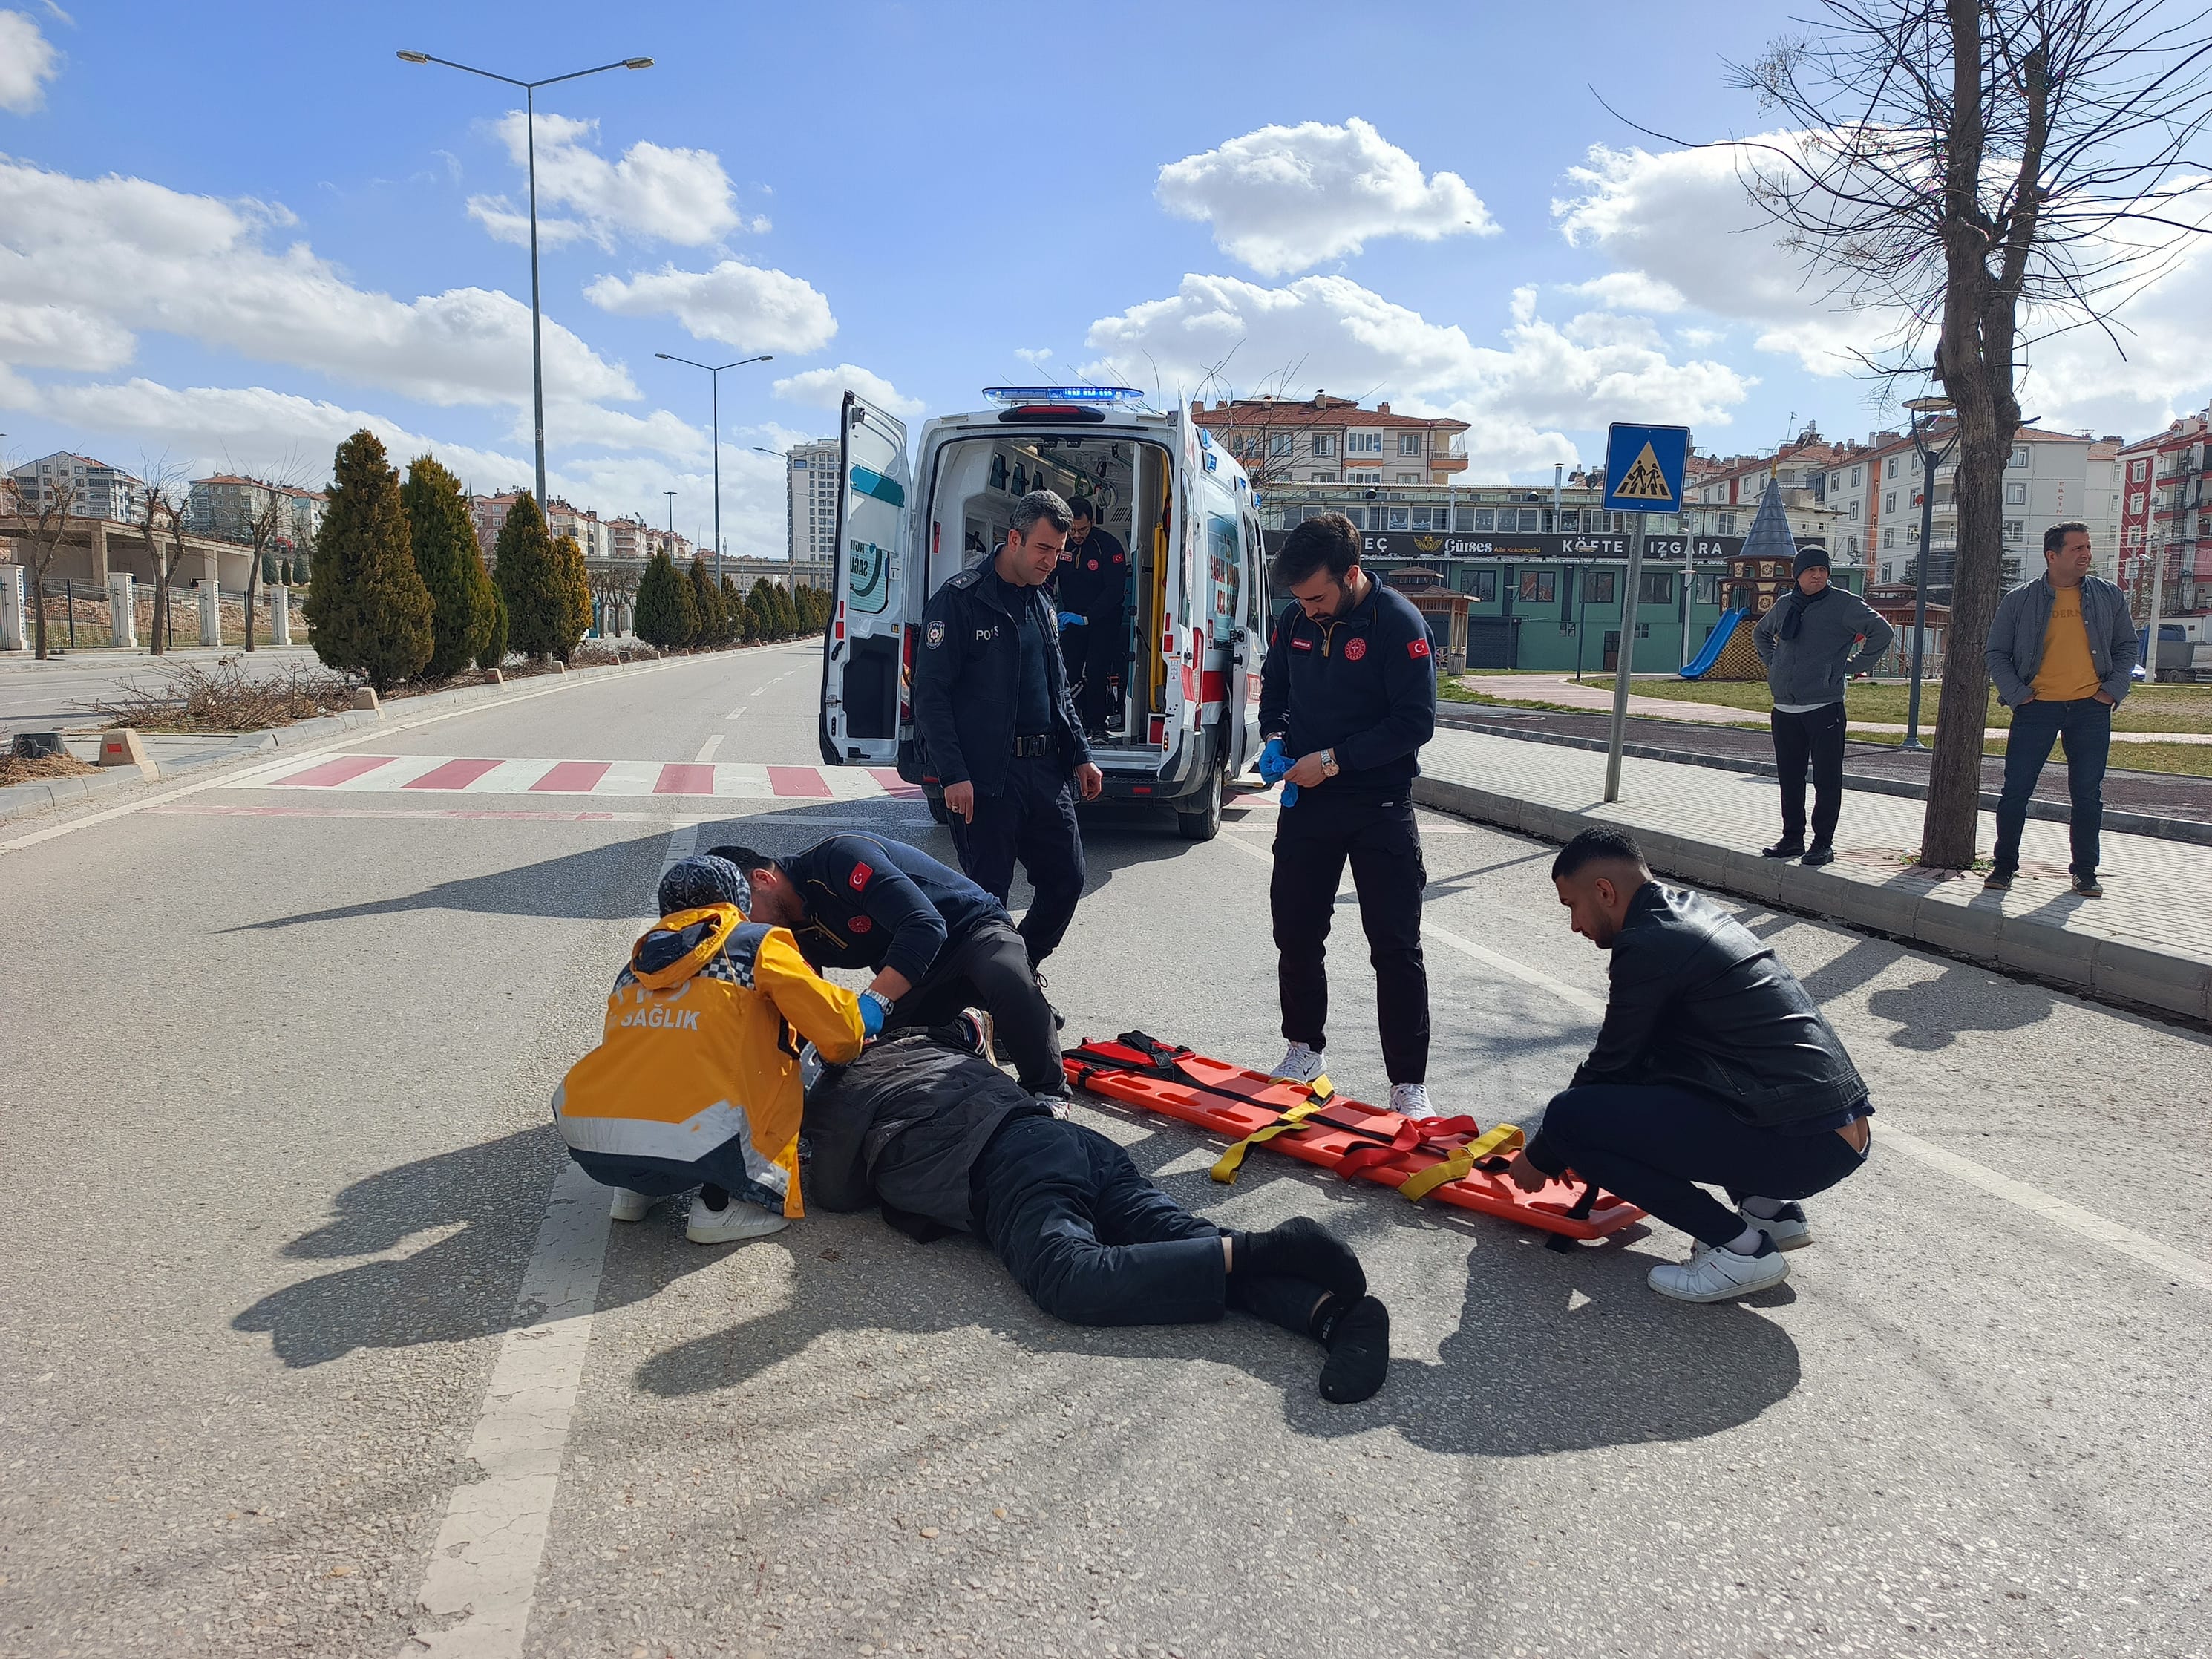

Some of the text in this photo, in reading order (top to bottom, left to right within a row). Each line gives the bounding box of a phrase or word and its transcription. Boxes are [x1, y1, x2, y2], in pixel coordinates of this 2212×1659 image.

[1364, 537, 1387, 553] EÇ
[2052, 609, 2081, 618] DERN
[976, 626, 999, 641] POS
[621, 1003, 701, 1031] SAĞLIK
